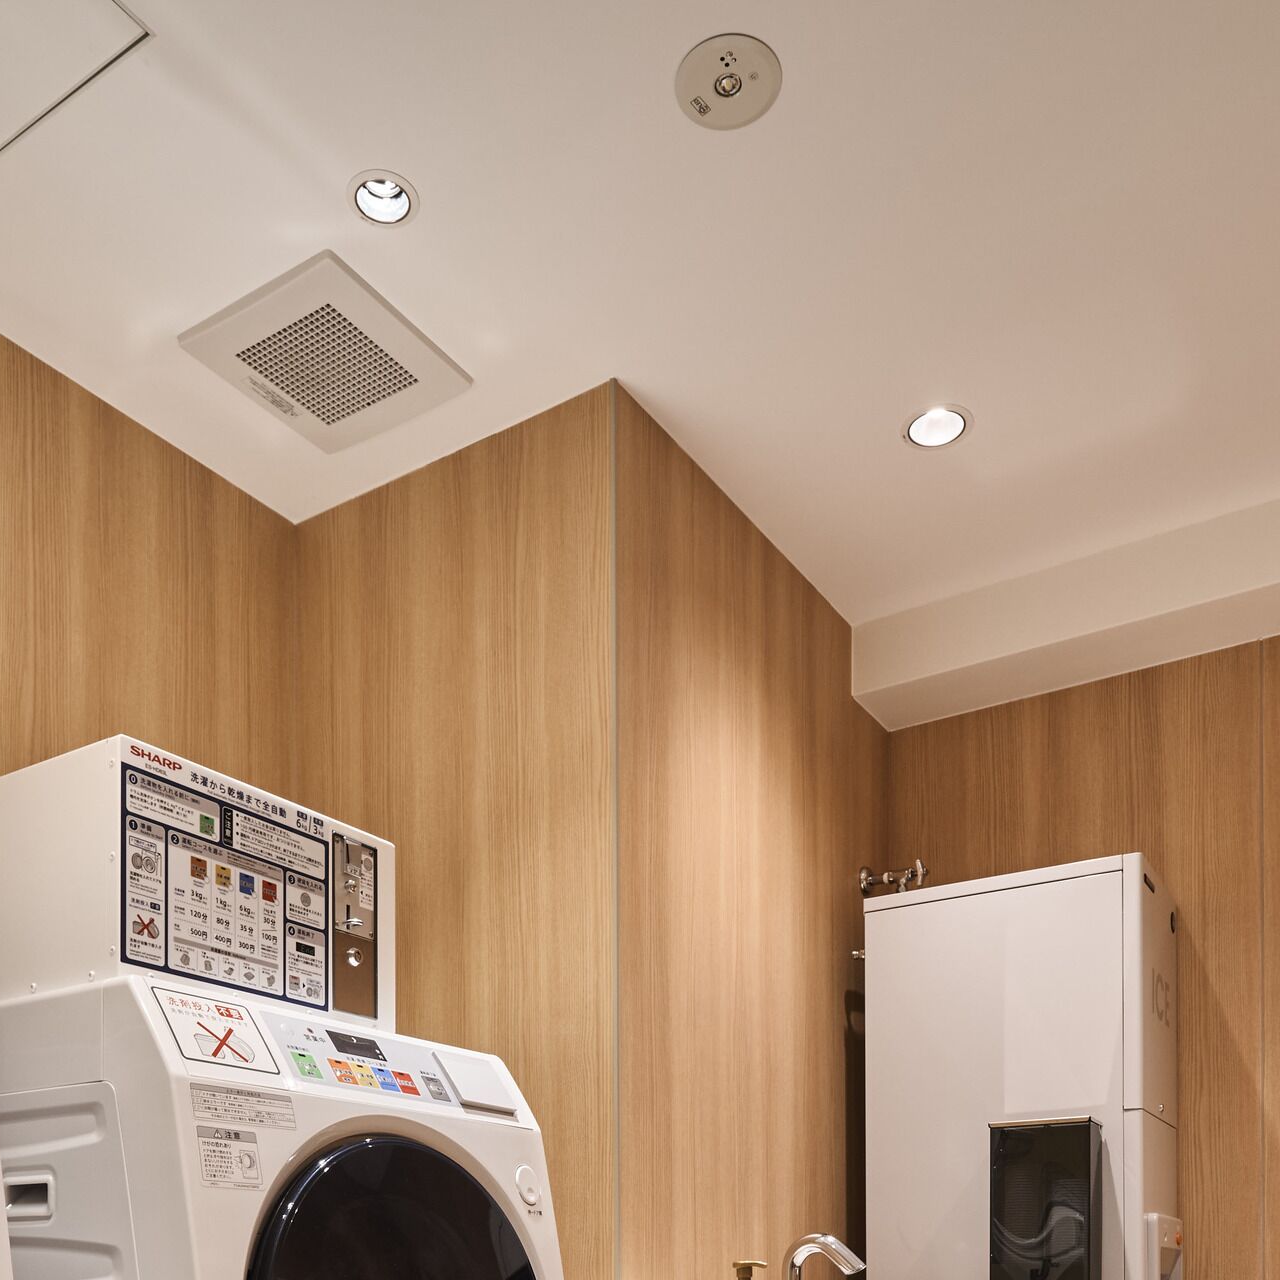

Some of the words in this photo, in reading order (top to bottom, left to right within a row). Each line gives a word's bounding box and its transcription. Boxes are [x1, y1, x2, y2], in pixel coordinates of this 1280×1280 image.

[130, 743, 182, 774] SHARP
[190, 770, 286, 819] 洗濯から乾燥まで全自動
[1152, 968, 1170, 1028] ICE
